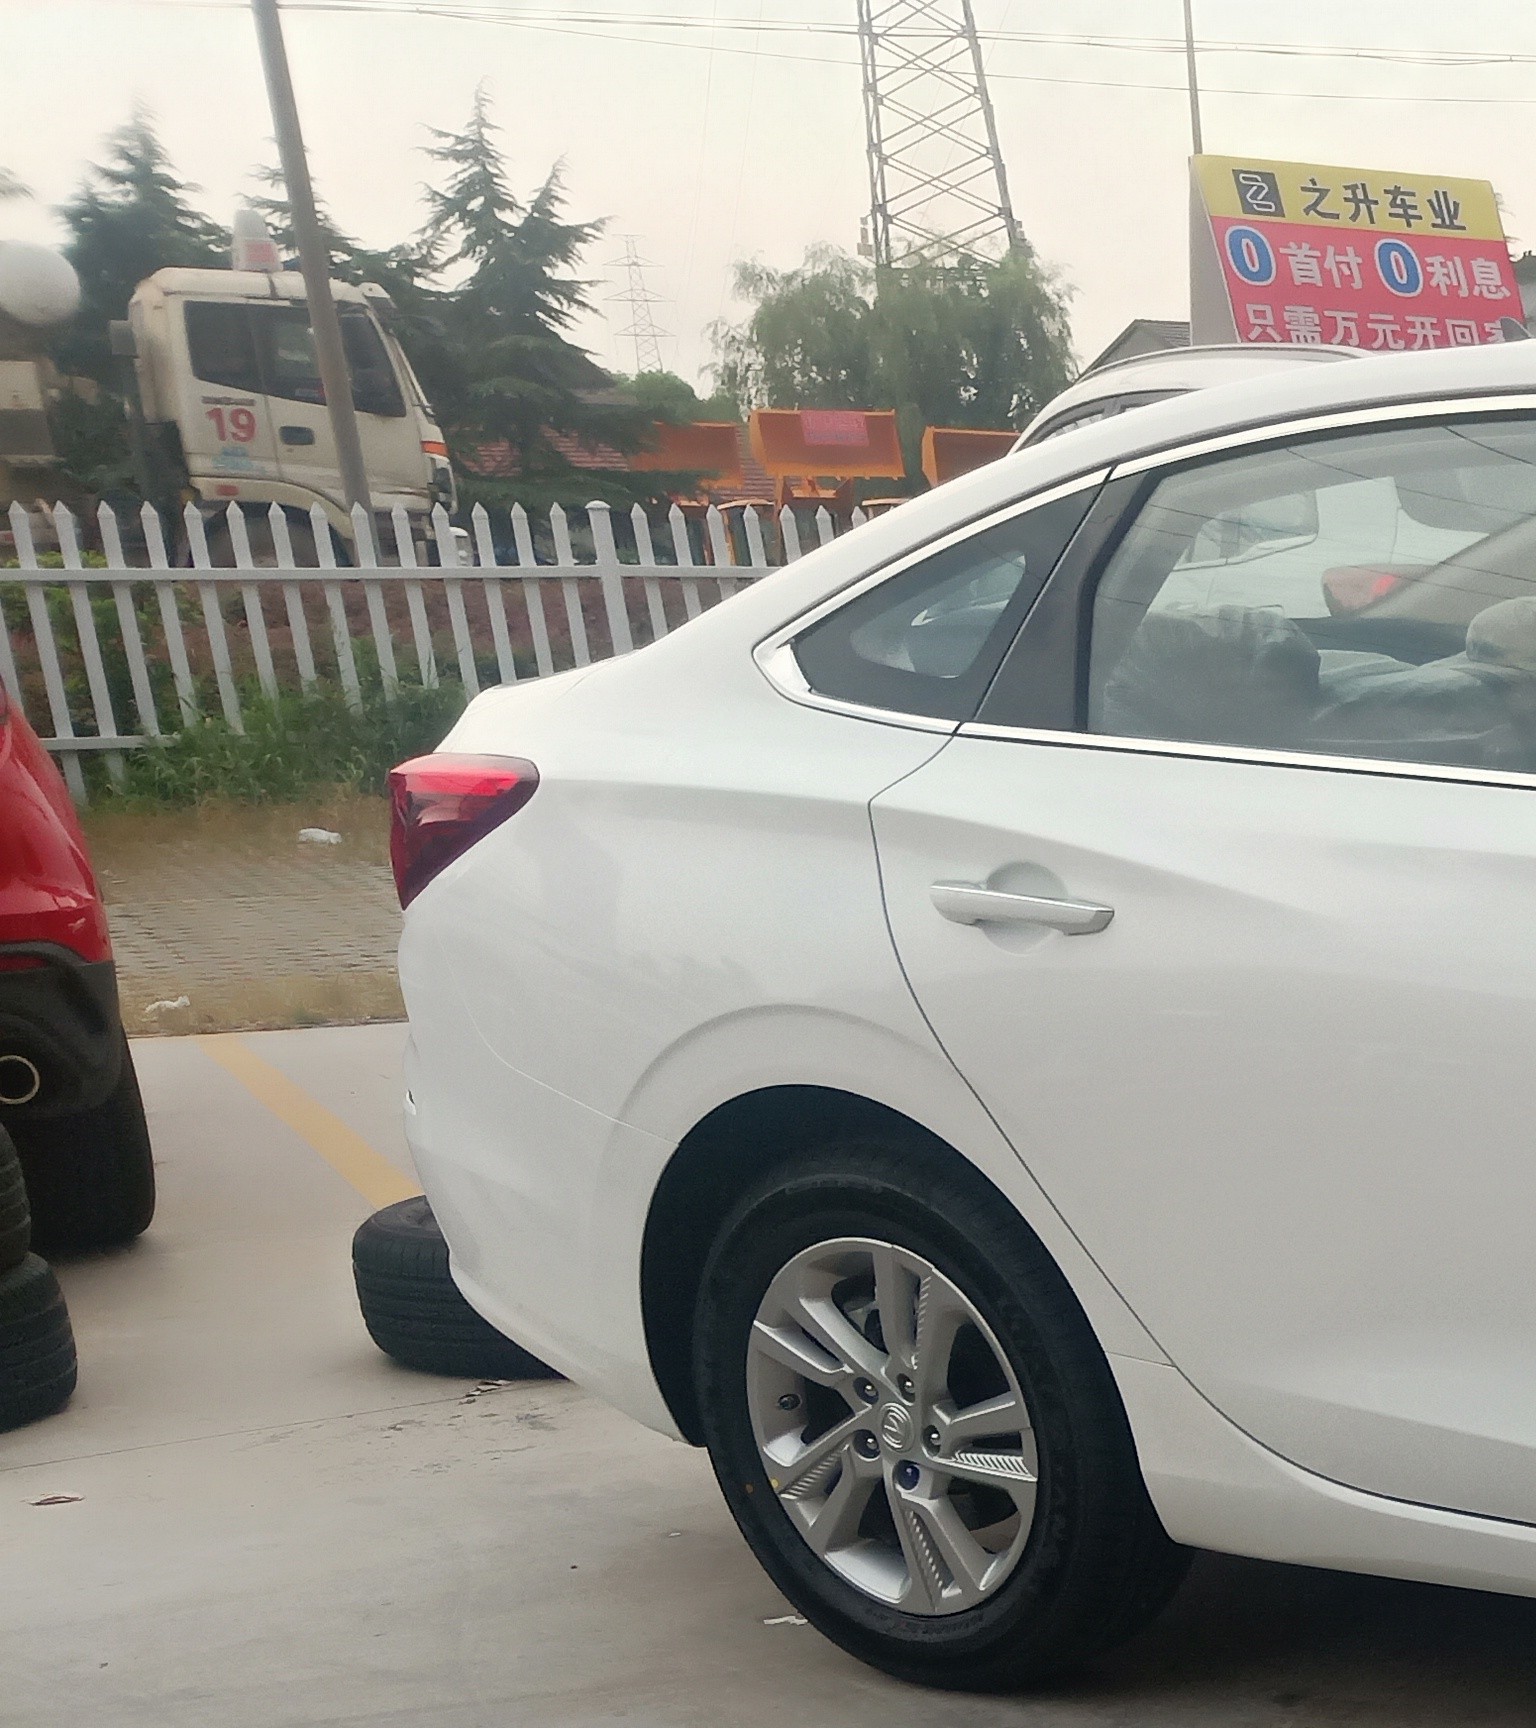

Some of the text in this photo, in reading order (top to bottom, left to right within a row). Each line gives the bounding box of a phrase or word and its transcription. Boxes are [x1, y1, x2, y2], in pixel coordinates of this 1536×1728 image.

[1300, 178, 1467, 231] 之升车业
[205, 407, 256, 442] 19
